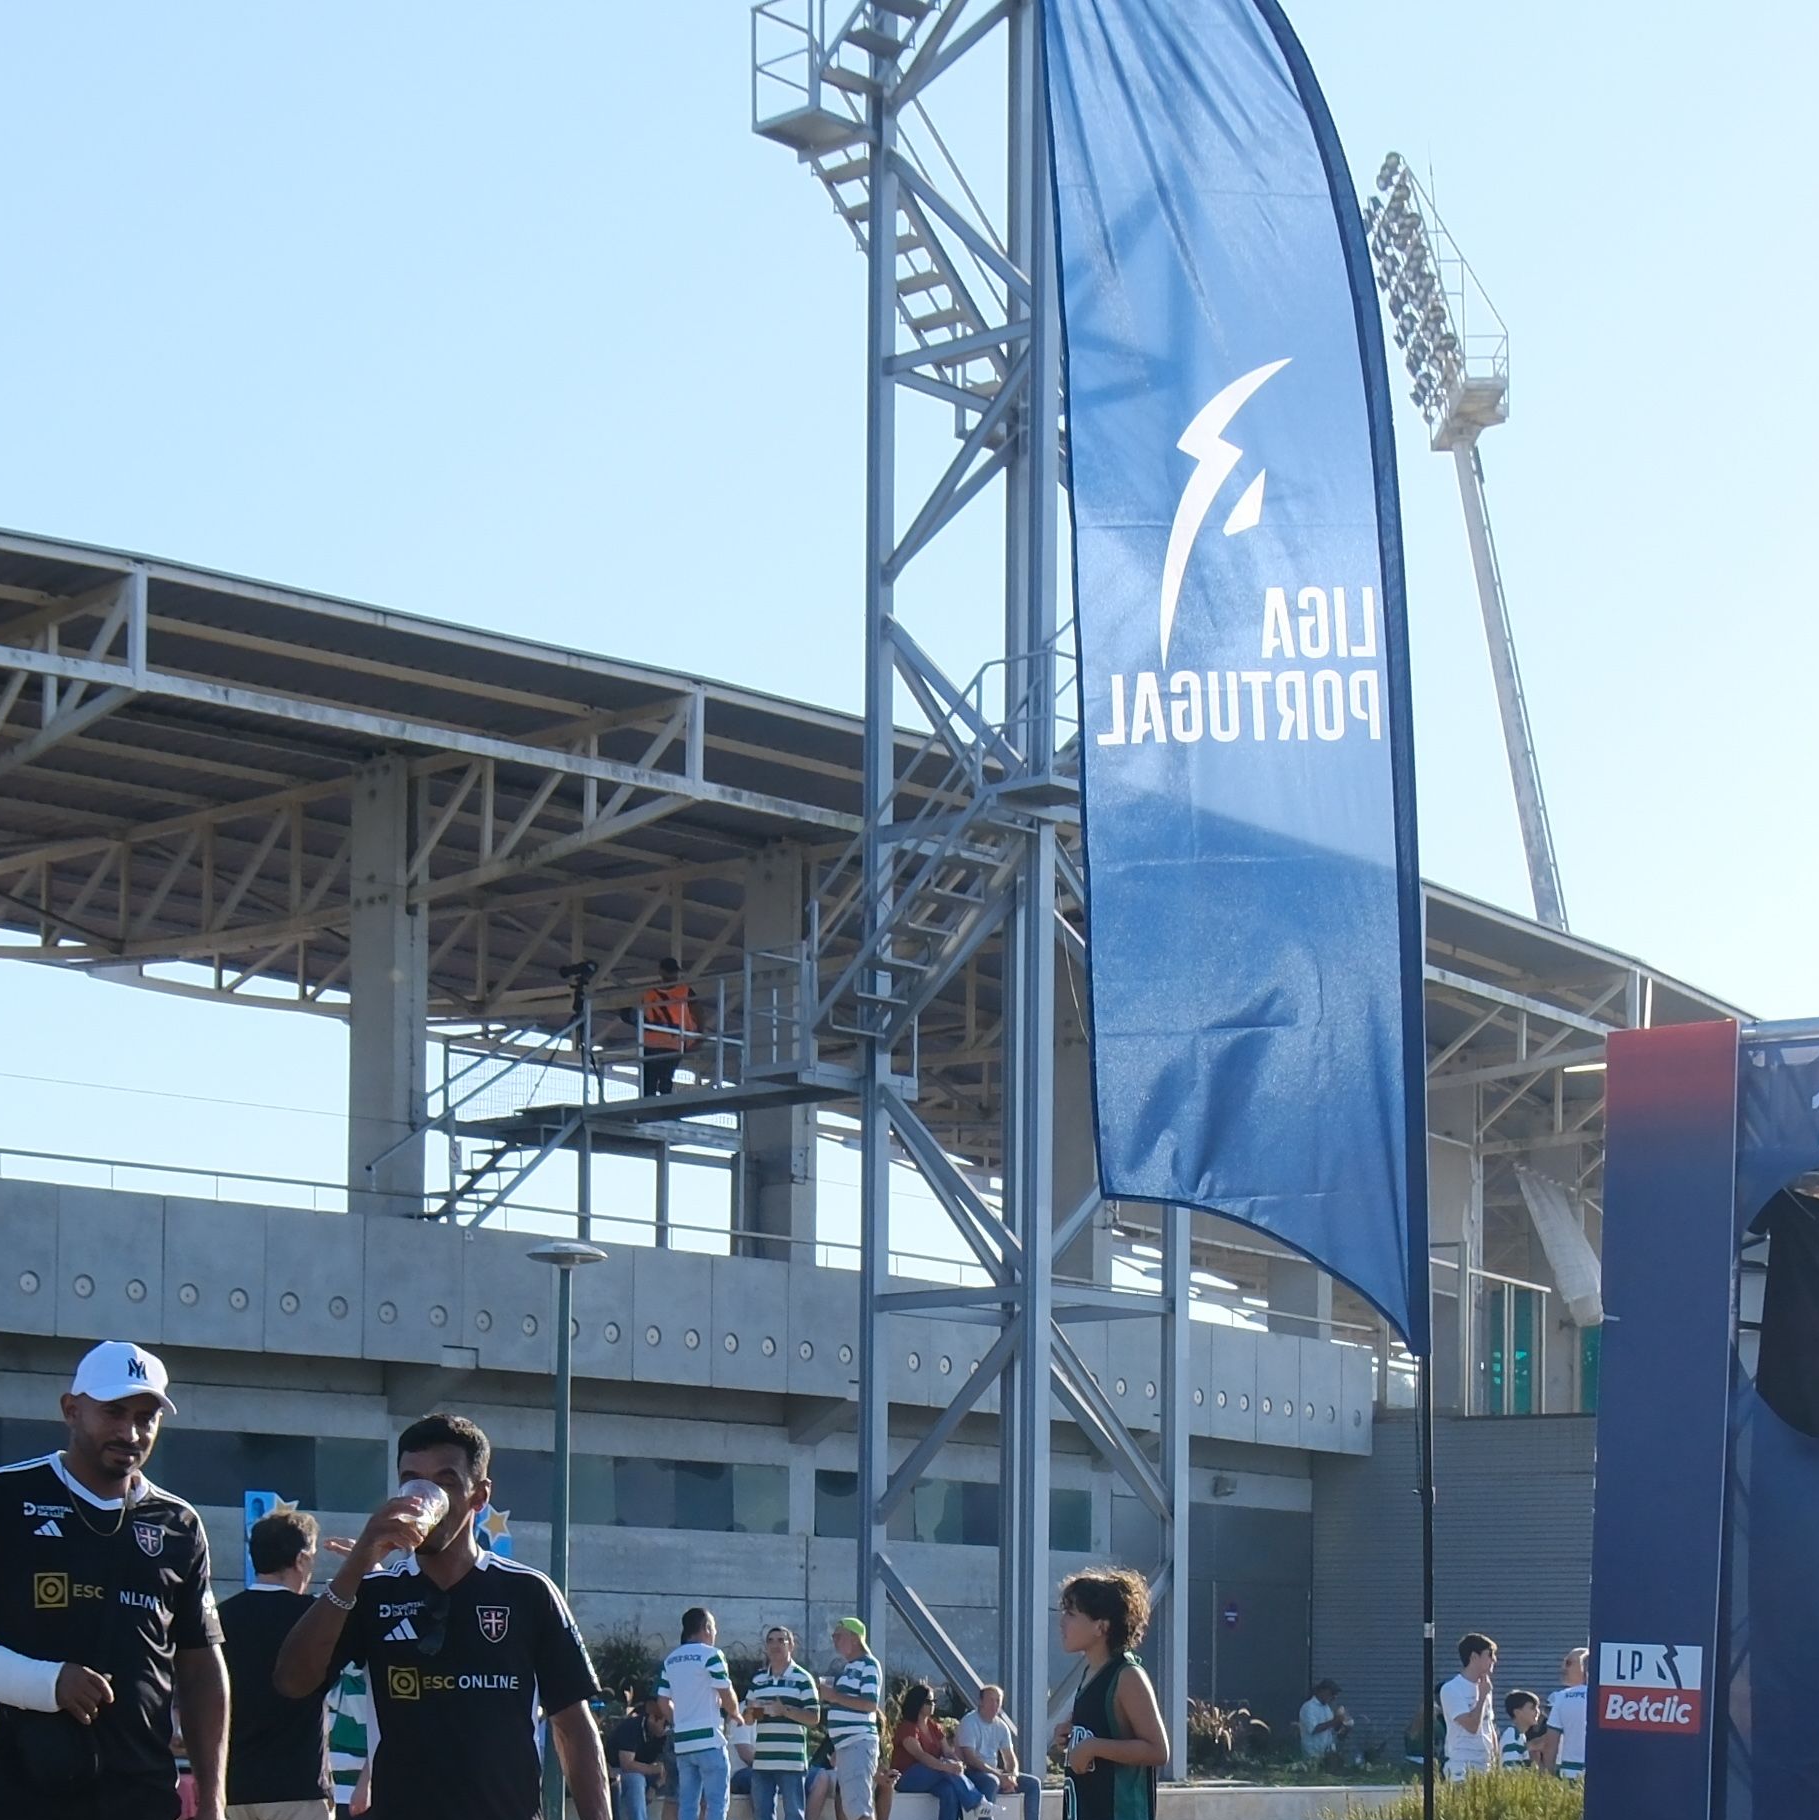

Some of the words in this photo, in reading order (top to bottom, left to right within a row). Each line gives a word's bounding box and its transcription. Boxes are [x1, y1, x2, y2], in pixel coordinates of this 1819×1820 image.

[72, 1583, 105, 1599] ESC
[422, 1675, 455, 1690] ESC
[458, 1674, 519, 1690] ONLINE
[1605, 1693, 1692, 1725] Betclic
